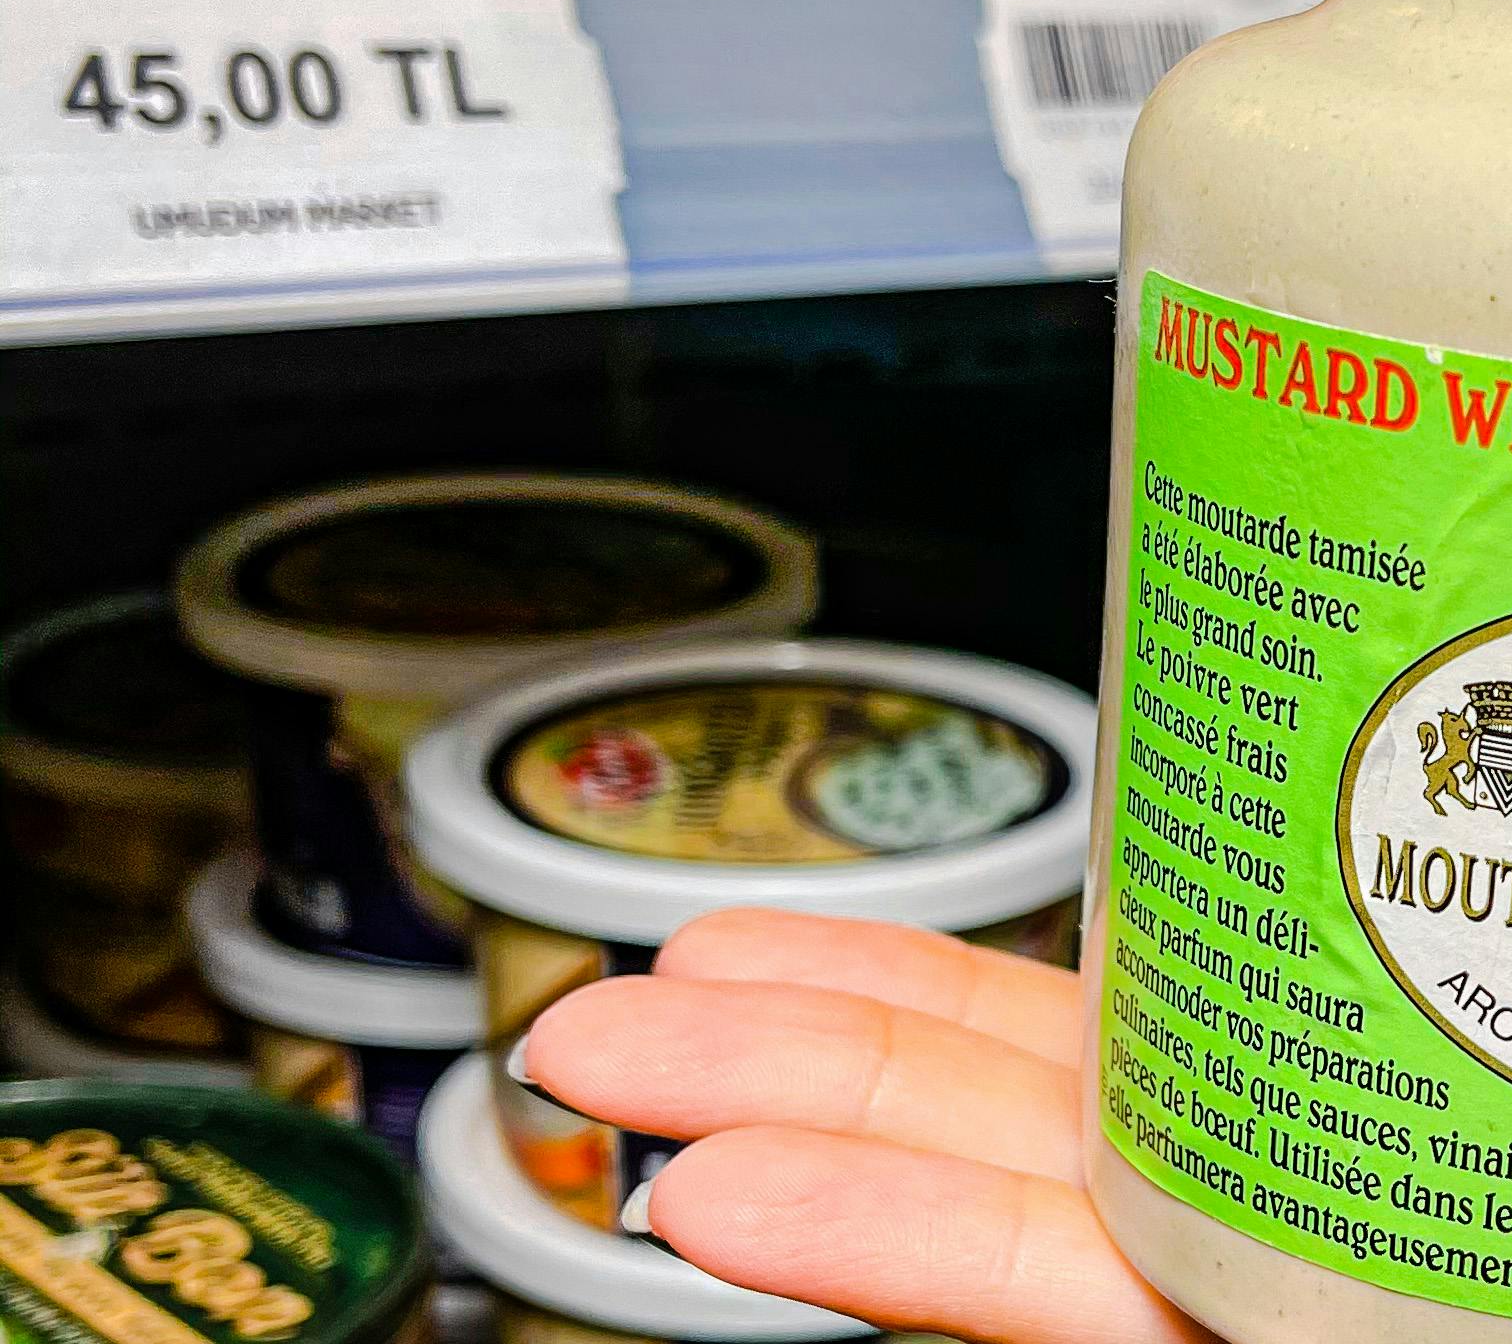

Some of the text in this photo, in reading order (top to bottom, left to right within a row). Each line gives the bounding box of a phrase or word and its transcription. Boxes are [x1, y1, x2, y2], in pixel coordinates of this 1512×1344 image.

[63, 43, 508, 146] 45,00 TL
[306, 193, 442, 232] MARKET
[1153, 296, 1420, 433] MUSTARD
[1142, 520, 1361, 634] a été élaborée avec
[1144, 459, 1427, 592] Cette moutarde tamisée
[1136, 619, 1300, 733] Le poivre vert
[1139, 568, 1323, 683] le plus grand soin.
[1130, 725, 1288, 839] incorporé à cette
[1133, 681, 1289, 784] concassé frais
[1122, 836, 1321, 960] apportera un déli-
[1126, 785, 1287, 896] moutarde vous
[1119, 887, 1366, 1034] cieux parfum qui saura
[1112, 988, 1198, 1077] culinaires,
[1204, 1049, 1245, 1098] tels
[1250, 1075, 1301, 1118] que
[1307, 1097, 1419, 1162] sauces,
[1116, 937, 1451, 1111] accommoder vos préparations
[1109, 1084, 1133, 1130] elle
[1136, 1112, 1246, 1205] parfumera
[1110, 1035, 1157, 1104] pièces
[1160, 1075, 1186, 1118] de
[1191, 1089, 1260, 1159] bœuf.
[1269, 1125, 1383, 1203] Utilisée
[1390, 1171, 1474, 1225] dans
